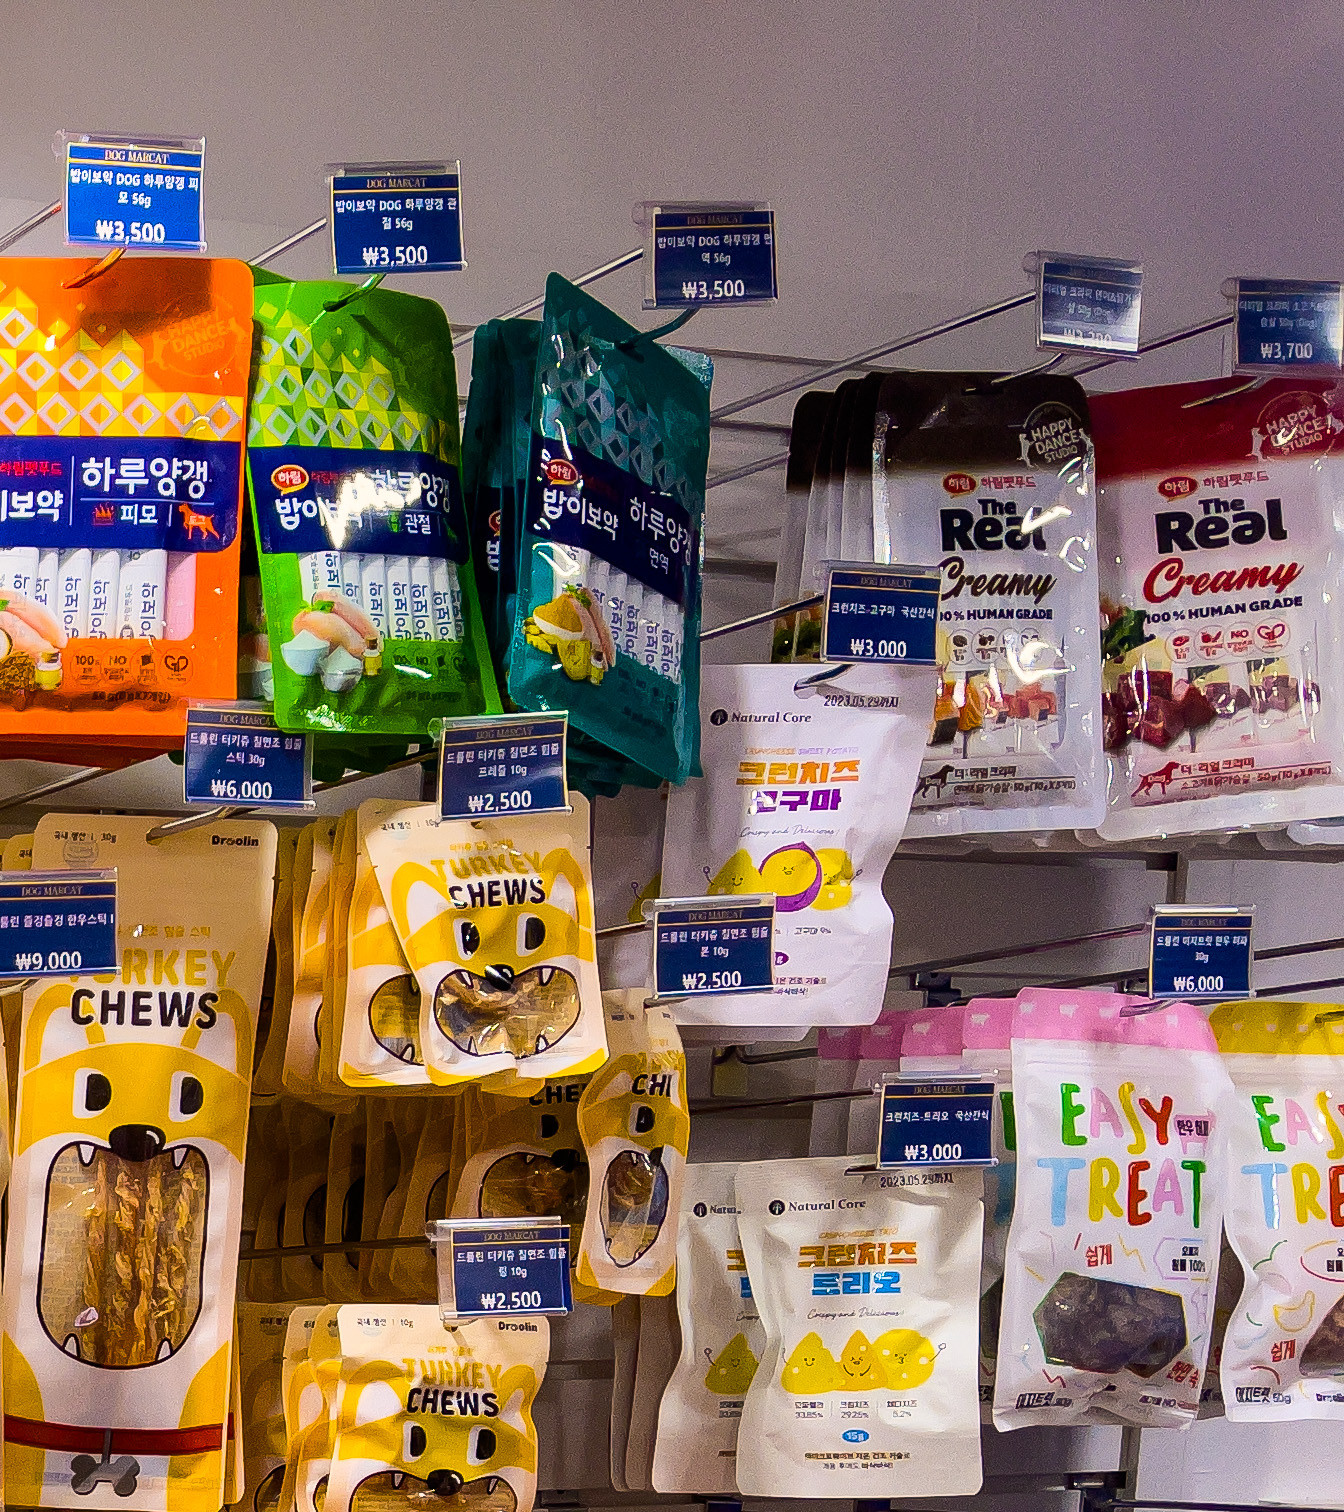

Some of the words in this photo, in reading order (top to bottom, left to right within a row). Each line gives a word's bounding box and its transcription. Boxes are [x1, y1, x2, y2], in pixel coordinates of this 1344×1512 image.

[1030, 421, 1073, 444] HAPPY
[81, 458, 210, 498] 하루양갱
[120, 503, 159, 526] 피모
[978, 499, 1017, 516] The
[1200, 497, 1245, 514] The
[1155, 506, 1288, 553] Real
[448, 879, 545, 909] CHEWS
[71, 989, 219, 1029] CHEWS
[1060, 1081, 1172, 1154] EASY
[1038, 1158, 1206, 1228] TREAT
[406, 1388, 499, 1418] CHEWS
